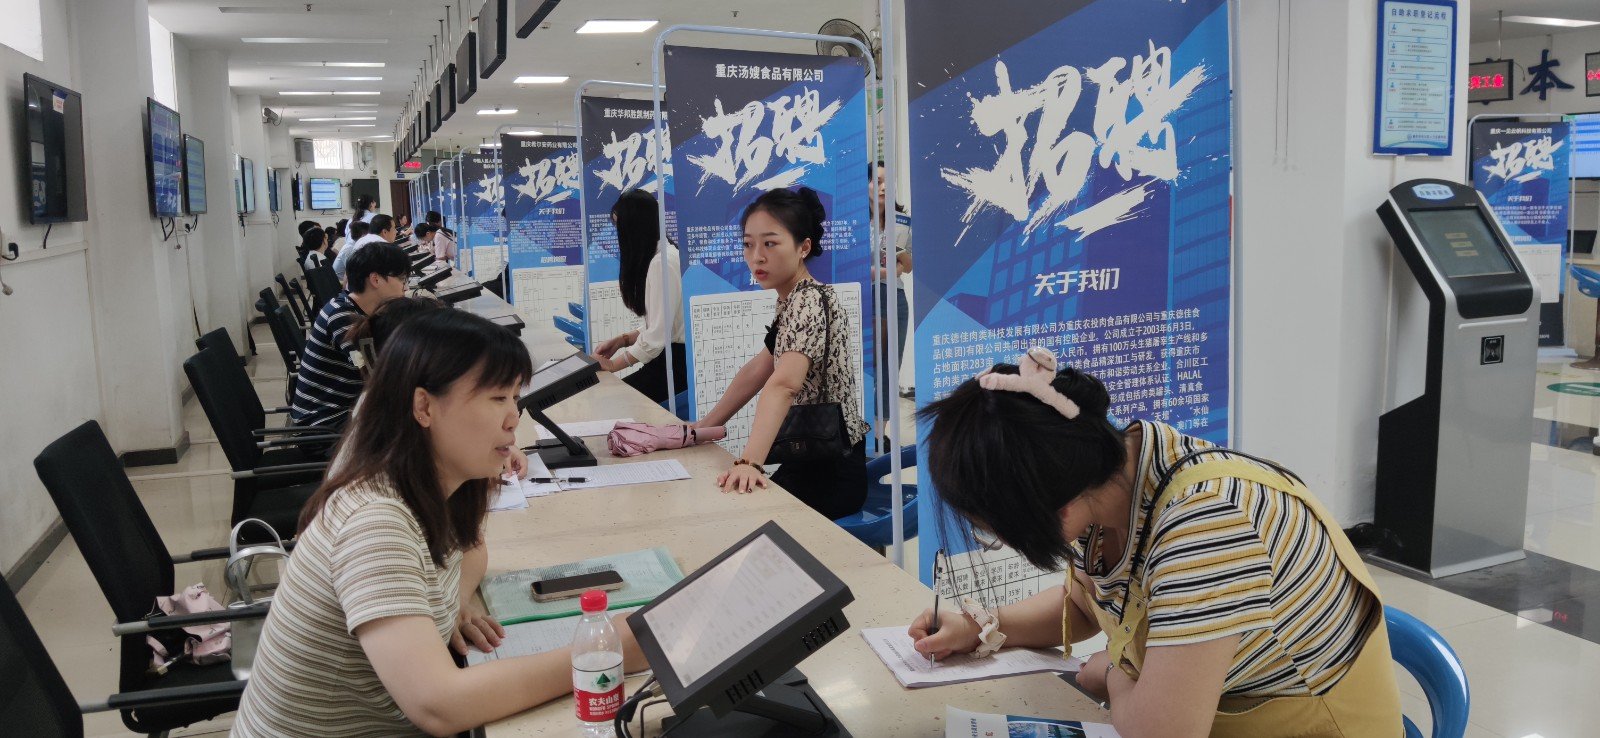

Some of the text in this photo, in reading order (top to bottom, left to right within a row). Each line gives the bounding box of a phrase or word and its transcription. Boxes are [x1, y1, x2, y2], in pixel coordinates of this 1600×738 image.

[715, 63, 824, 83] 重庆汤嫂食品有限公司
[1519, 49, 1575, 101] 本
[686, 87, 842, 198] 招聘
[941, 39, 1211, 246] 招聘
[1482, 135, 1564, 184] 招聘
[511, 151, 580, 205] 招聘
[538, 208, 565, 216] 关于我们
[1034, 267, 1120, 298] 关于我们
[588, 693, 619, 706] 农夫山泉
